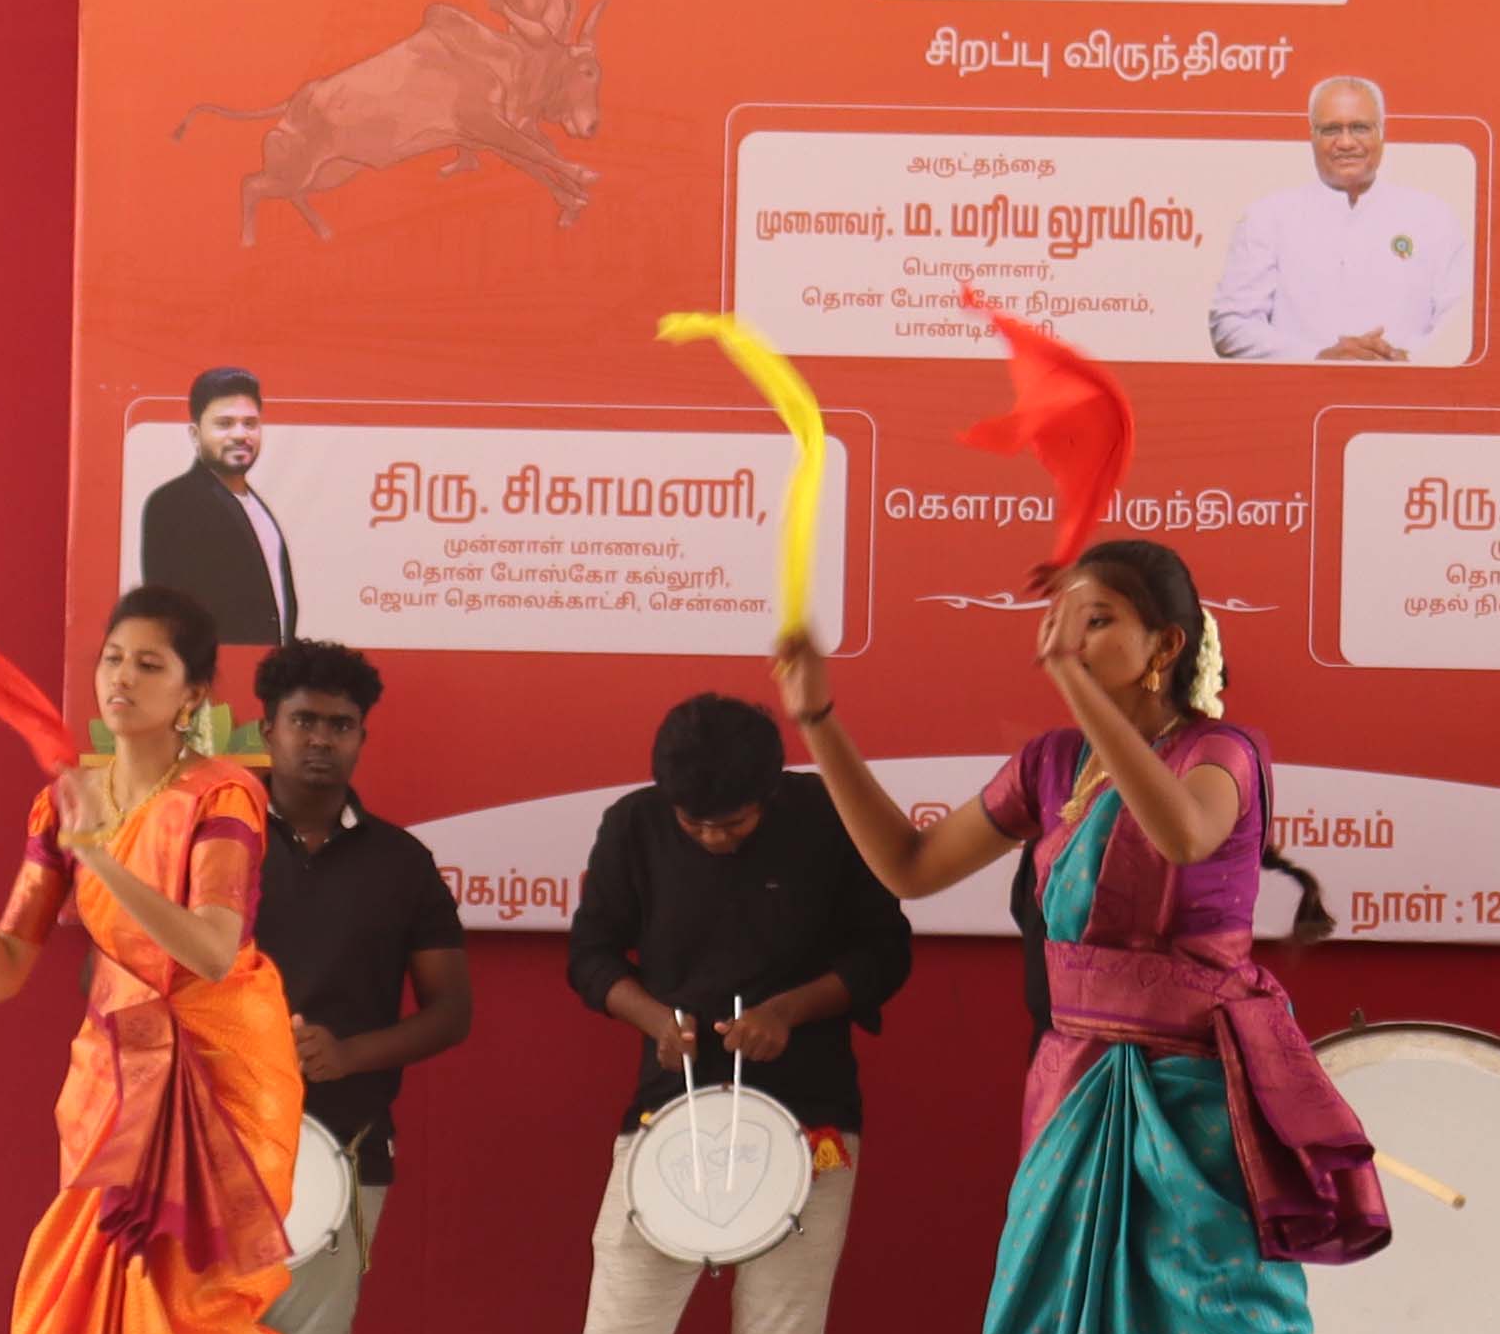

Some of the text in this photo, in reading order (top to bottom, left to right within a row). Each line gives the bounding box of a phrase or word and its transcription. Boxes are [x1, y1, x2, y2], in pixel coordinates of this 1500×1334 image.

[925, 26, 1293, 81] சிறப்பு விருந்தினர்
[906, 153, 1056, 180] அருட்தந்தை
[756, 205, 894, 241] முனைவர்.
[802, 287, 884, 310] தொன்
[370, 462, 767, 528] திரு. சிகாமணி,
[444, 533, 563, 558] முன்னாள்
[403, 560, 484, 587] தொன்
[491, 562, 618, 585] போஸ்கோ
[360, 585, 438, 613] ஜெயா
[1404, 592, 1468, 616] முதல்
[1350, 884, 1447, 934] நாள்
